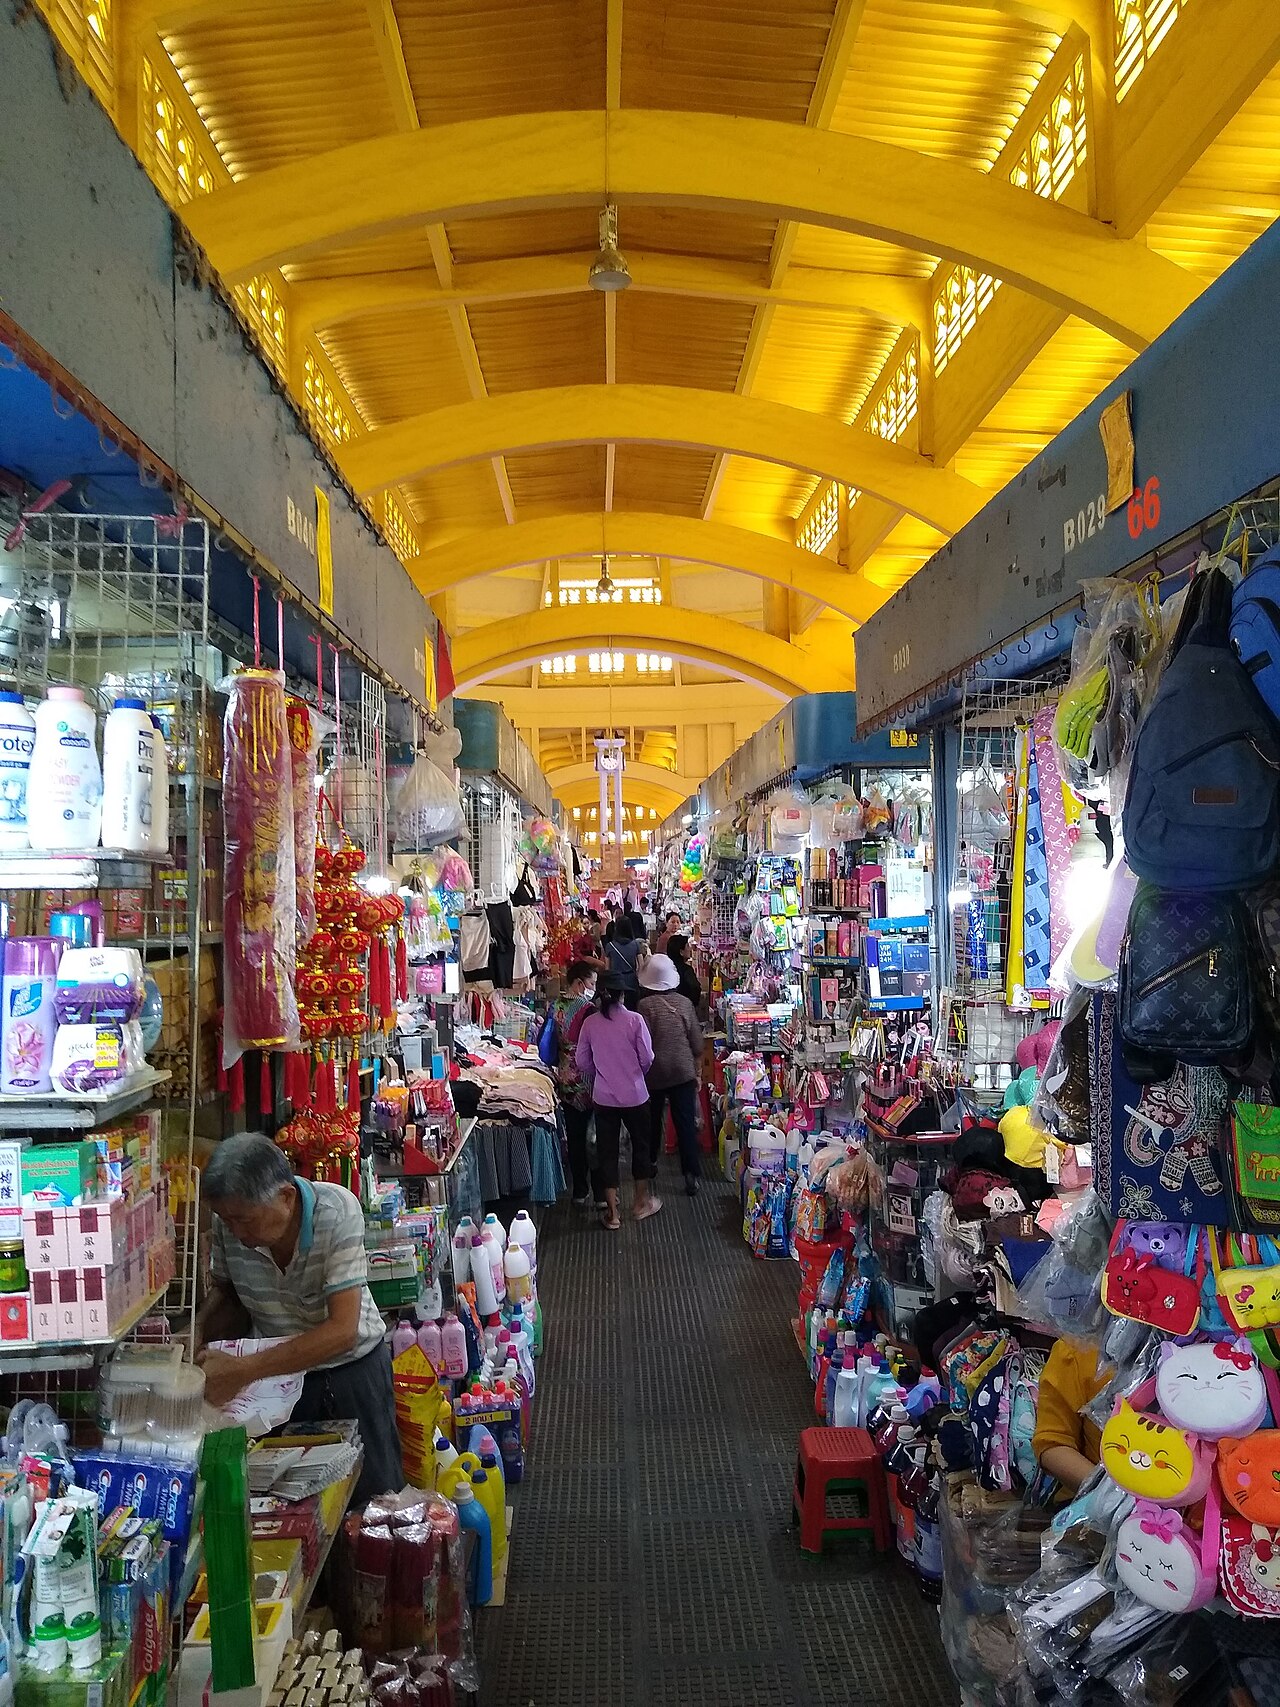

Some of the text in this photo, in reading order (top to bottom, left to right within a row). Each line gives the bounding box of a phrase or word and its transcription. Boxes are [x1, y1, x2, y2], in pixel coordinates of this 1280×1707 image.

[1063, 494, 1106, 555] B029
[1127, 475, 1160, 540] 66
[97, 1468, 112, 1519] Cres
[131, 1472, 147, 1519] Cres
[164, 1477, 183, 1529] Crest
[143, 1612, 156, 1673] Colgate
